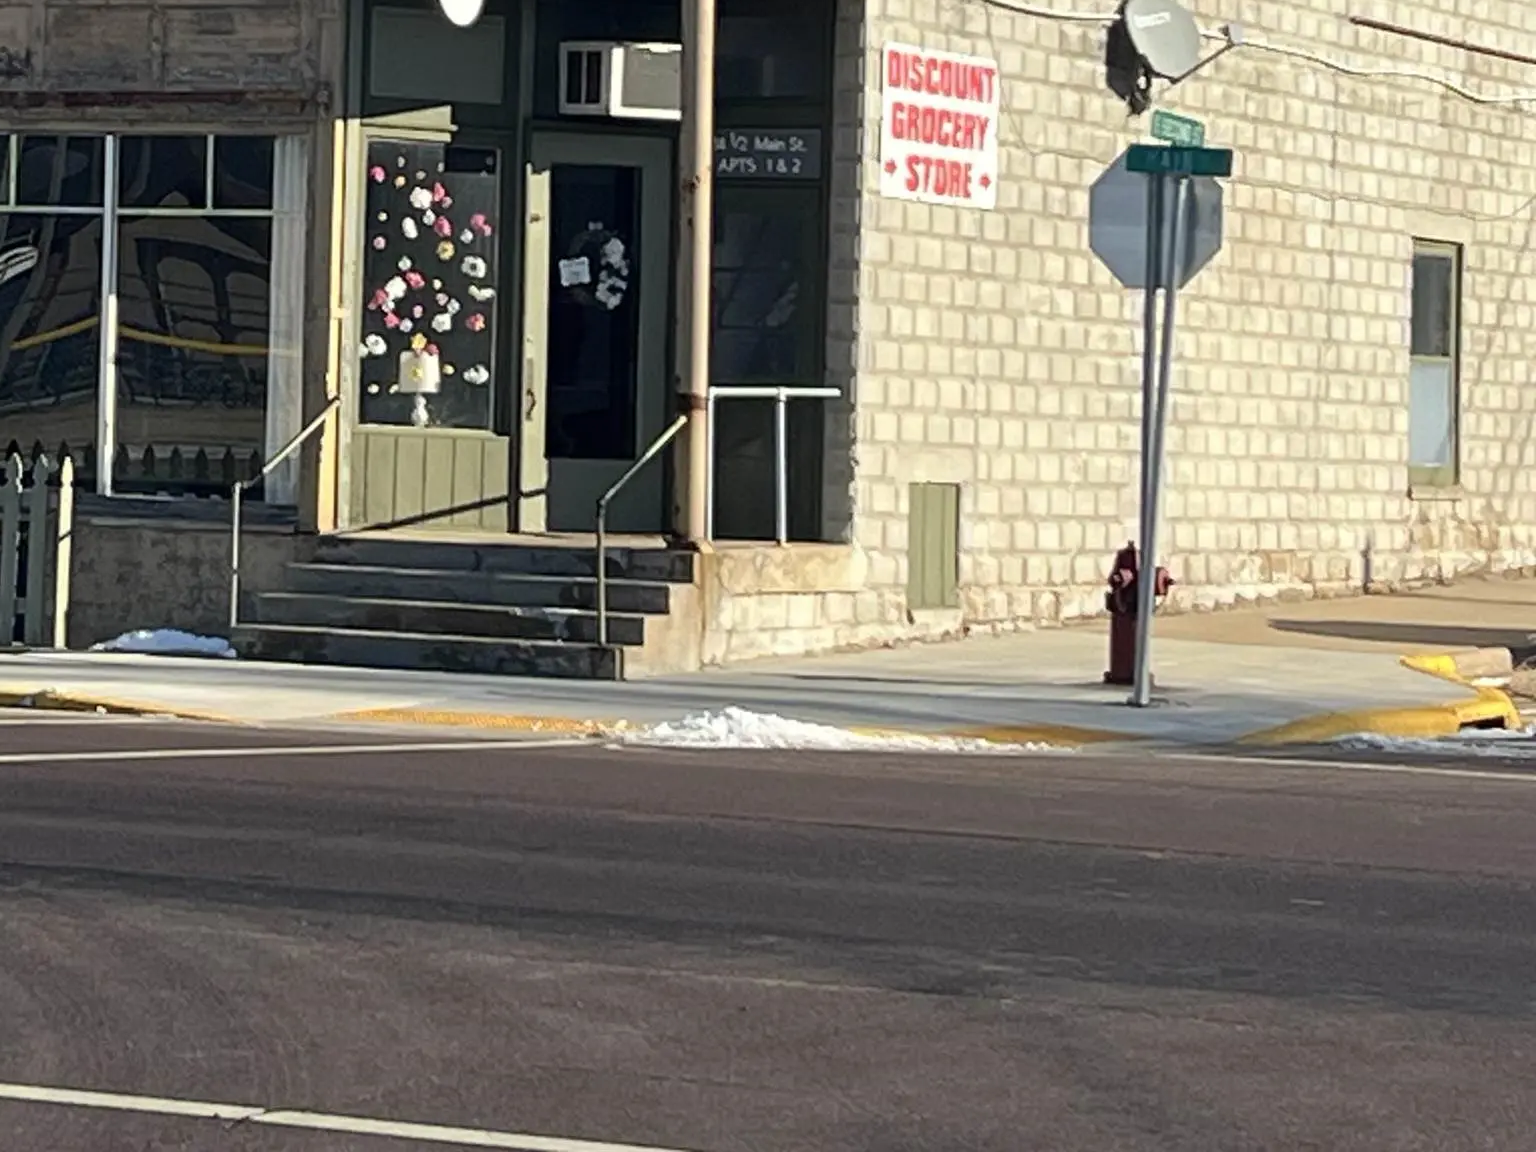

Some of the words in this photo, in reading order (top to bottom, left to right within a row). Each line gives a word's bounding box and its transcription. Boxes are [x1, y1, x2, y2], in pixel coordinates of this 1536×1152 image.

[888, 50, 996, 103] DISCOUNT
[892, 102, 990, 151] GROCERY
[718, 157, 757, 173] APTS
[766, 158, 773, 173] 1
[776, 158, 788, 173] &
[791, 157, 802, 174] 2
[905, 154, 972, 198] STORE
